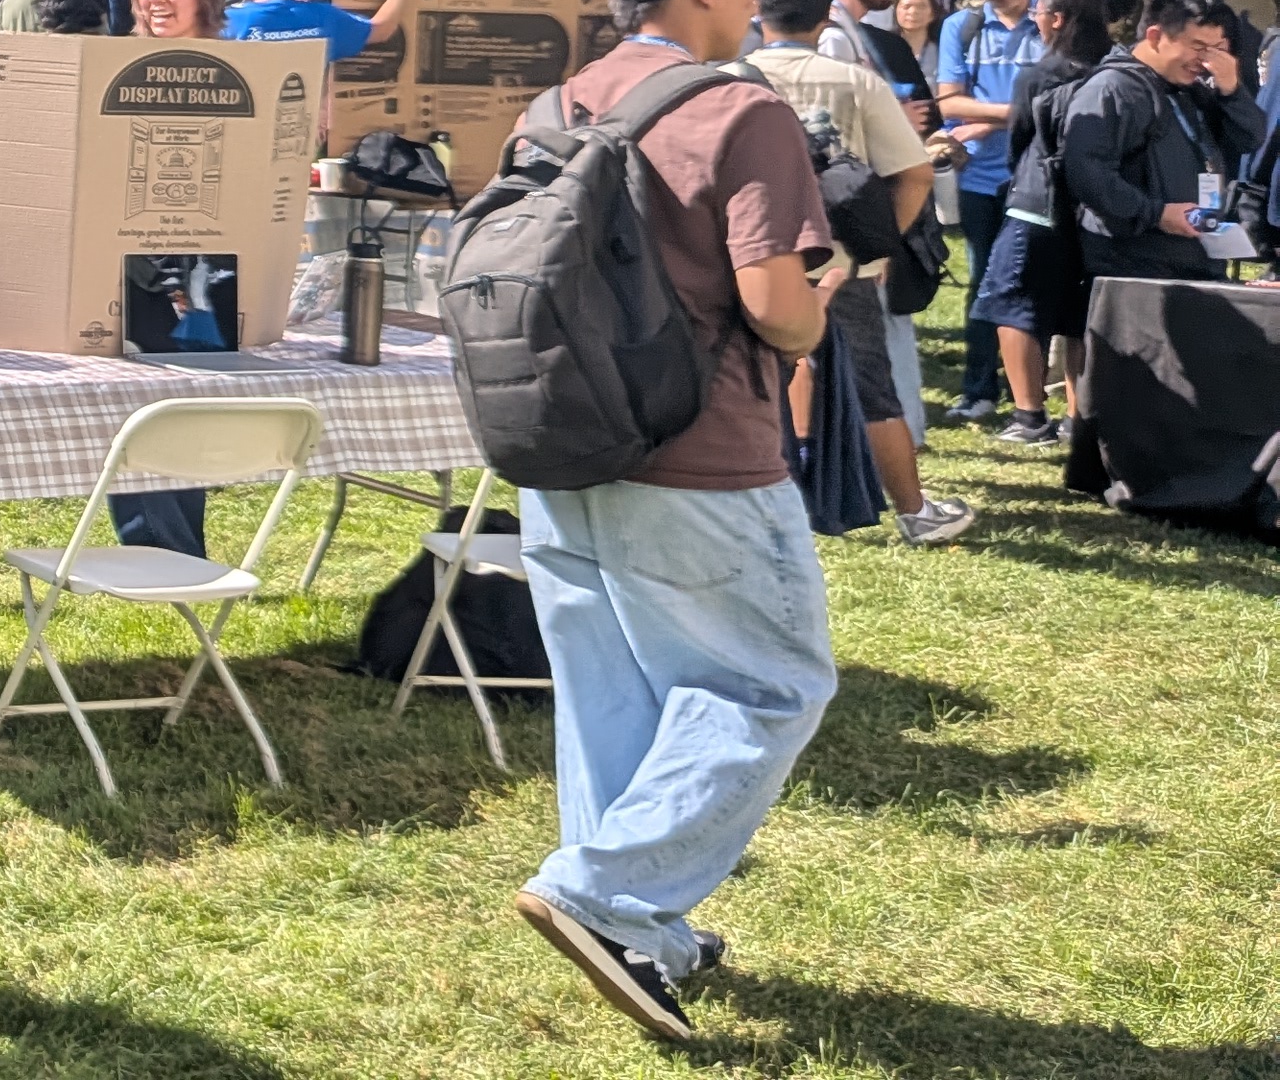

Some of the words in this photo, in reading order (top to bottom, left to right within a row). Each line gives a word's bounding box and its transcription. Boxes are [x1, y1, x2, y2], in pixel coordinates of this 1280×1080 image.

[146, 66, 217, 83] PROJECT
[119, 86, 185, 104] DISPLAY
[188, 88, 240, 105] BOARD
